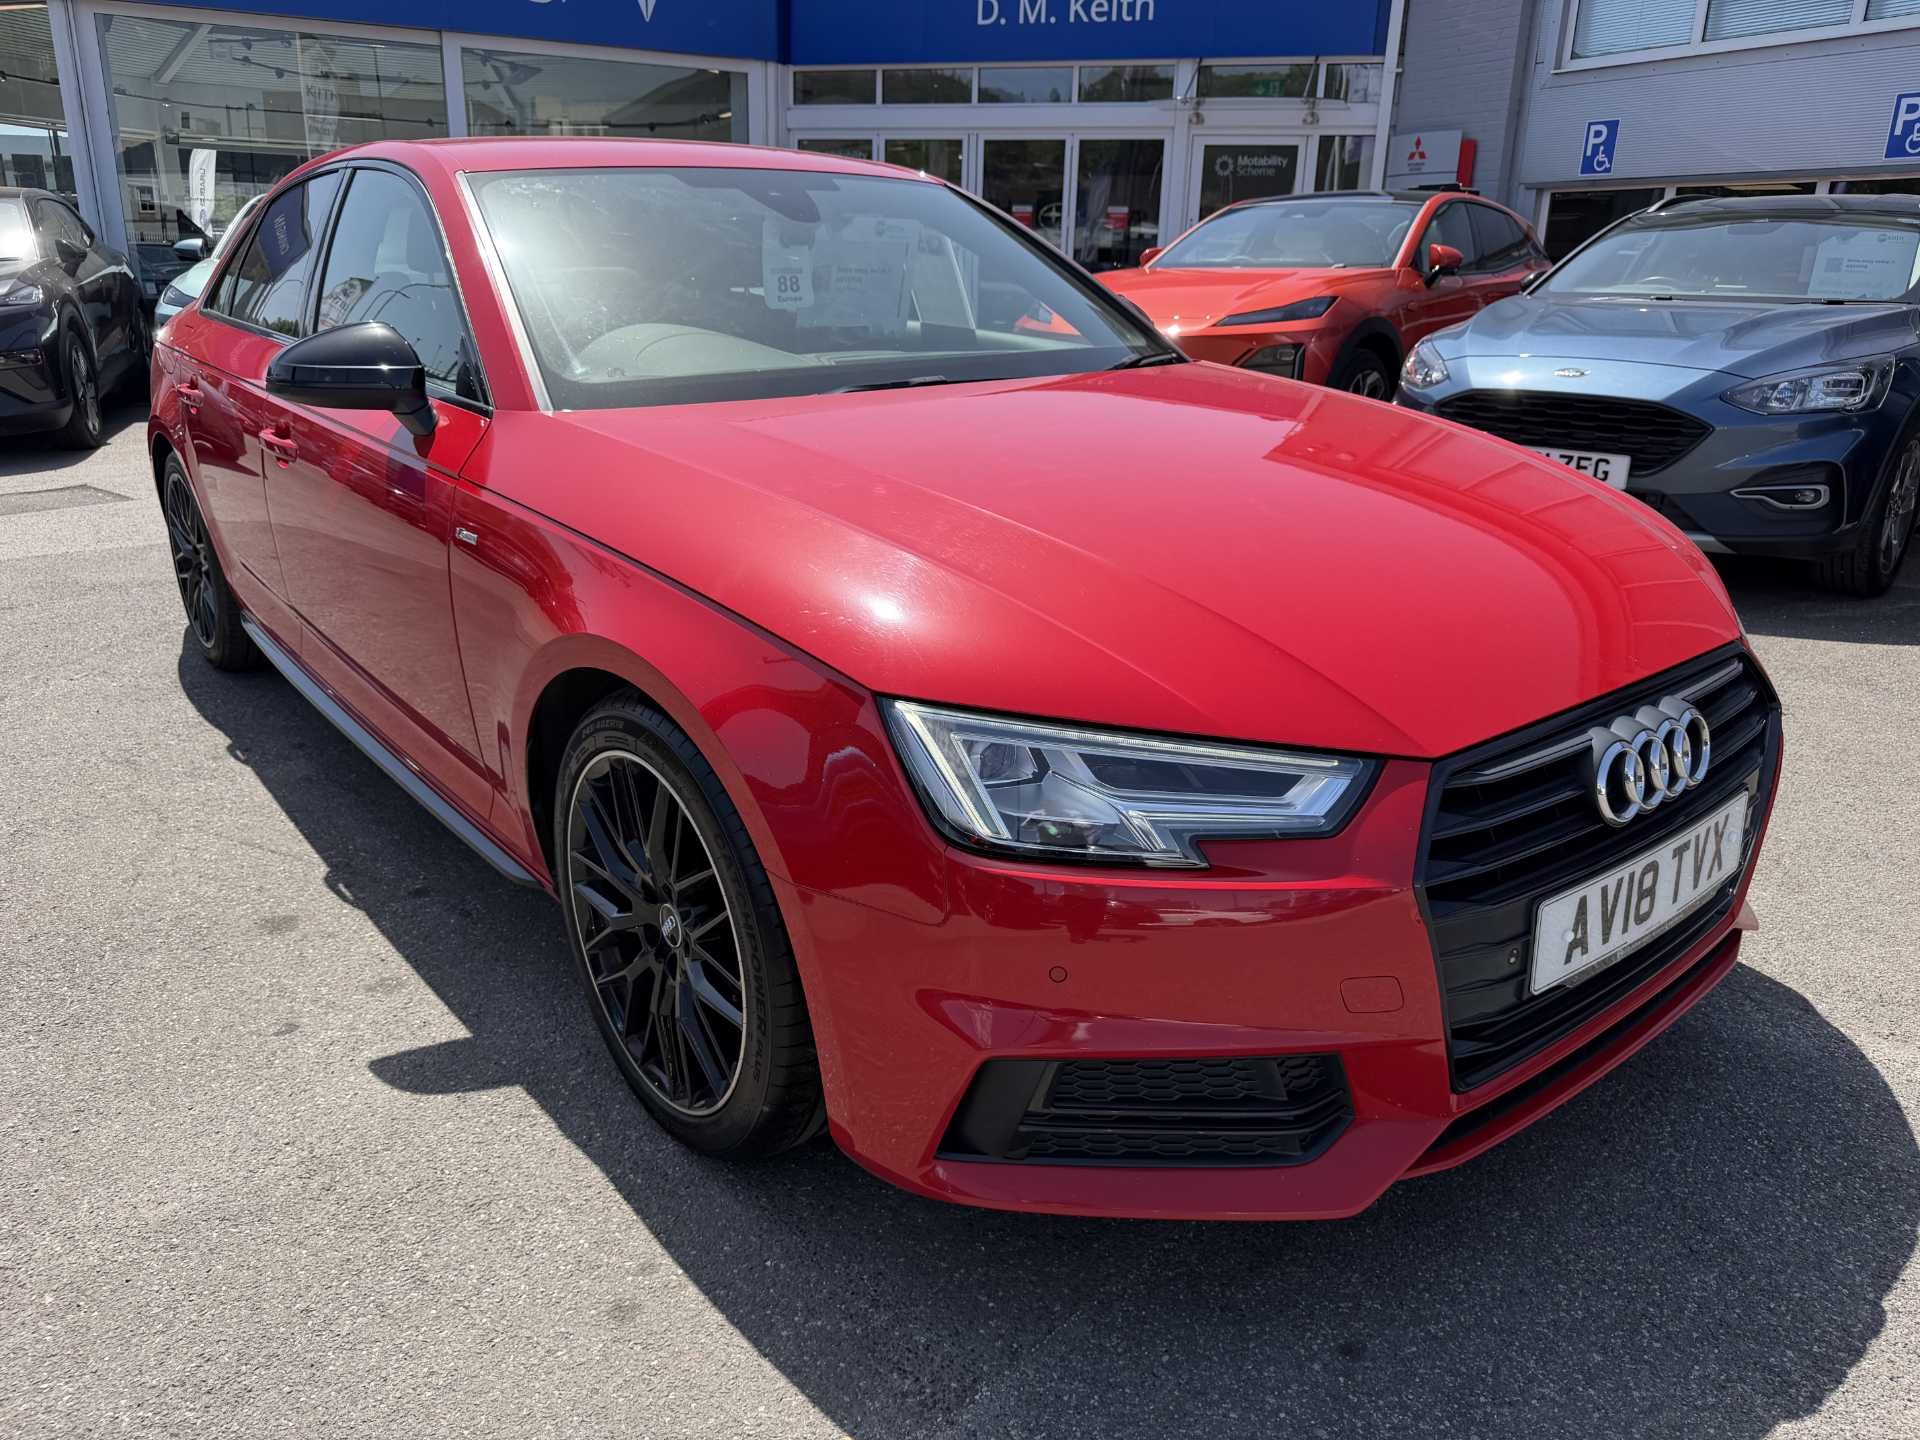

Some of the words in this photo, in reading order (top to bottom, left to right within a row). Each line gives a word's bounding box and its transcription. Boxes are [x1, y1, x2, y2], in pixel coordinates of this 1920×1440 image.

[976, 0, 1007, 25] D.
[1018, 0, 1056, 25] M.
[1068, 0, 1155, 23] Keith
[1893, 97, 1920, 136] P
[1585, 124, 1608, 157] P
[1237, 154, 1289, 168] Motability
[1237, 166, 1276, 177] Scheme
[777, 275, 801, 293] 88
[1563, 859, 1660, 966] AV18
[1671, 812, 1731, 906] TVX
